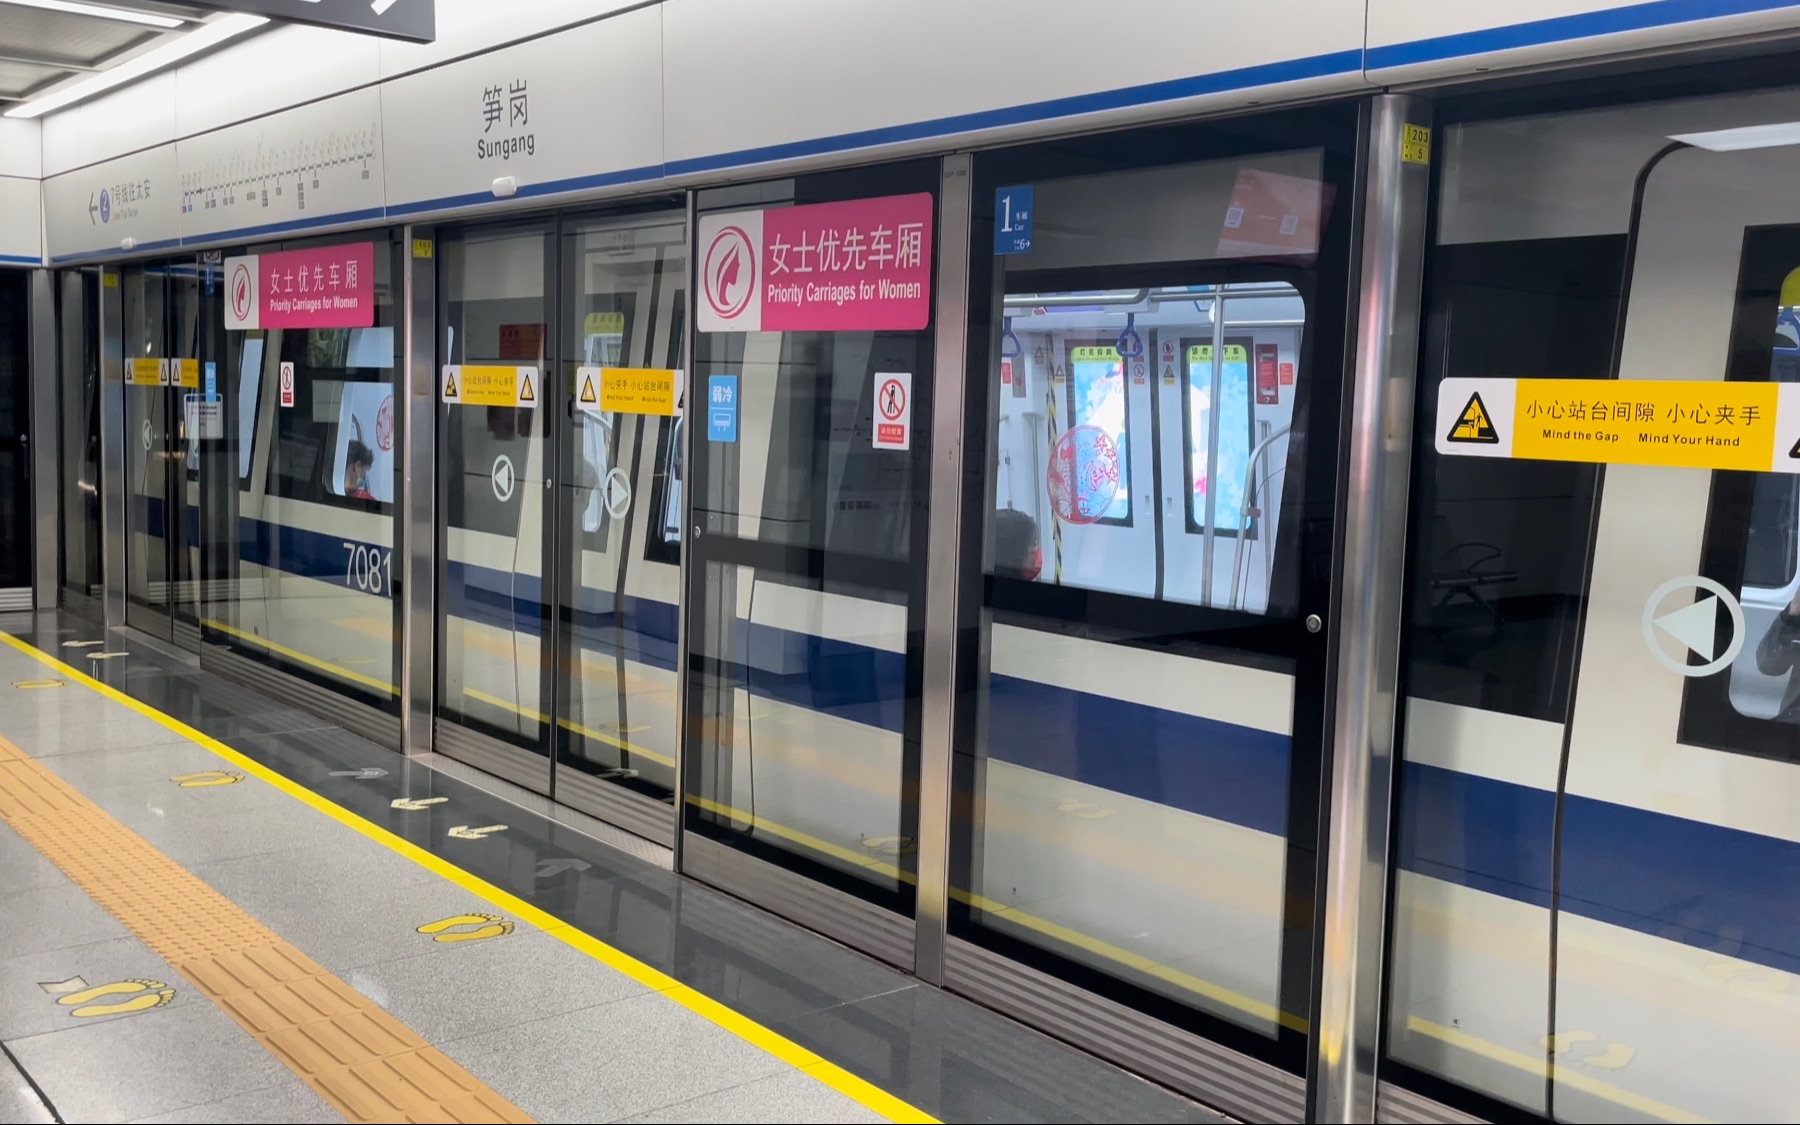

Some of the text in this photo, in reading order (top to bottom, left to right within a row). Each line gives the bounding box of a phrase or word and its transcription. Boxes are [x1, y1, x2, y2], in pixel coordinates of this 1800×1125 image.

[482, 79, 528, 133] 笋岗
[477, 134, 534, 160] Sungang
[1413, 129, 1429, 143] 203
[1418, 148, 1423, 160] 5
[1001, 195, 1012, 232] 1
[769, 222, 923, 276] 女士优先车厢
[270, 260, 358, 294] 女士优先车厢
[270, 295, 358, 314] Priority Carriages for Women
[768, 279, 921, 307] Priority Carriages for Women
[712, 385, 733, 403] 弱冷
[1526, 399, 1761, 426] 小心站台间隙 小心夹手
[1542, 429, 1740, 447] Mind the Gap Mind Your Hand
[343, 542, 391, 597] 7081
